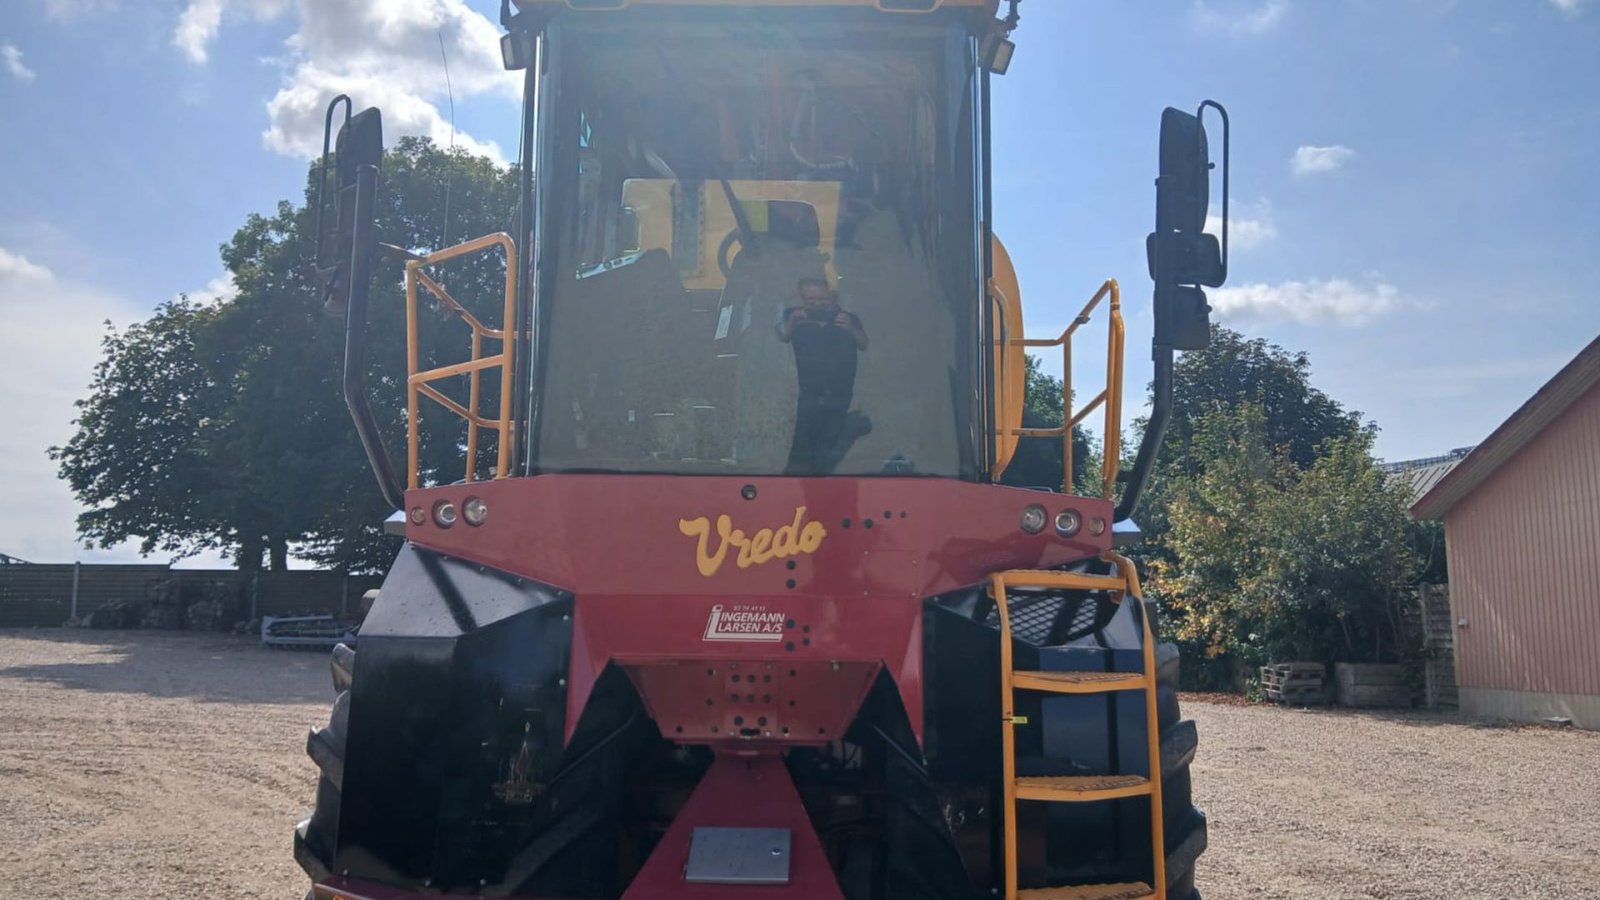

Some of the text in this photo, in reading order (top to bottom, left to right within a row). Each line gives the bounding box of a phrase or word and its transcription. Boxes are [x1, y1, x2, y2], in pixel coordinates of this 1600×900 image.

[679, 506, 827, 576] Vredo
[720, 612, 785, 622] INGEMANN
[718, 622, 784, 632] LARSEN A/S
